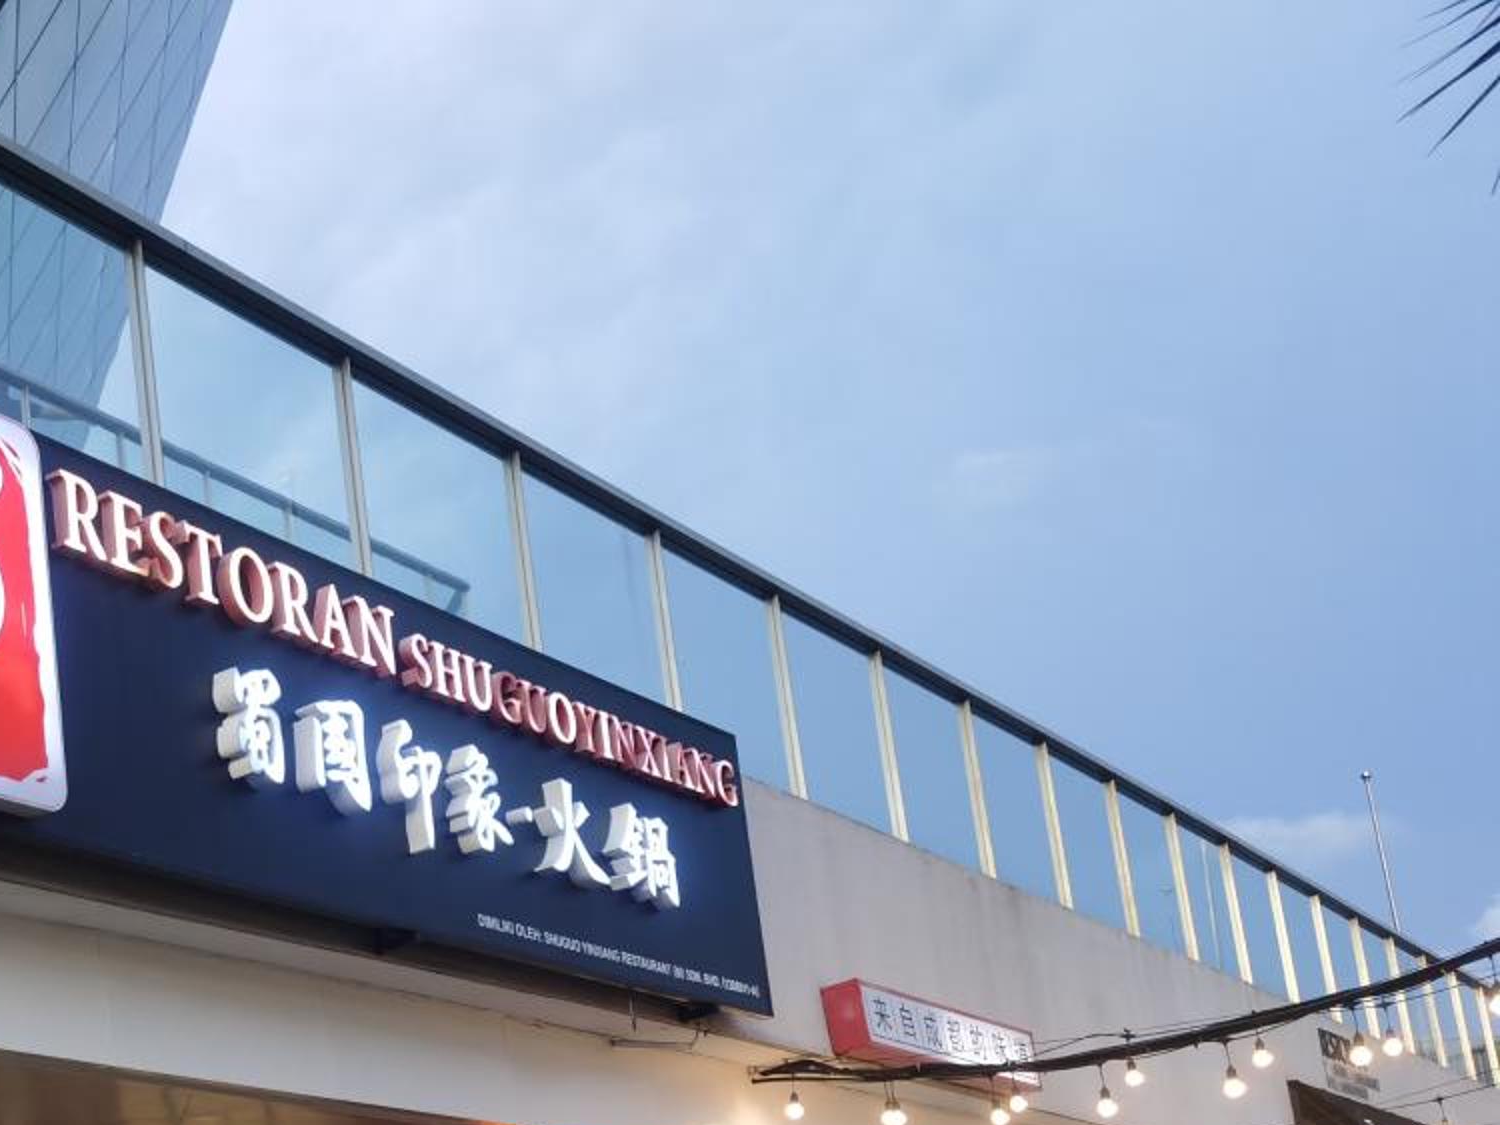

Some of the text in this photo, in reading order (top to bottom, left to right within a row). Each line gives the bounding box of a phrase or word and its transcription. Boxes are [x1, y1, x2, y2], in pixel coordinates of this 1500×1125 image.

[46, 468, 738, 806] RESTORAN SHUGUOYINXIANG
[621, 950, 671, 975] RESTAURANT
